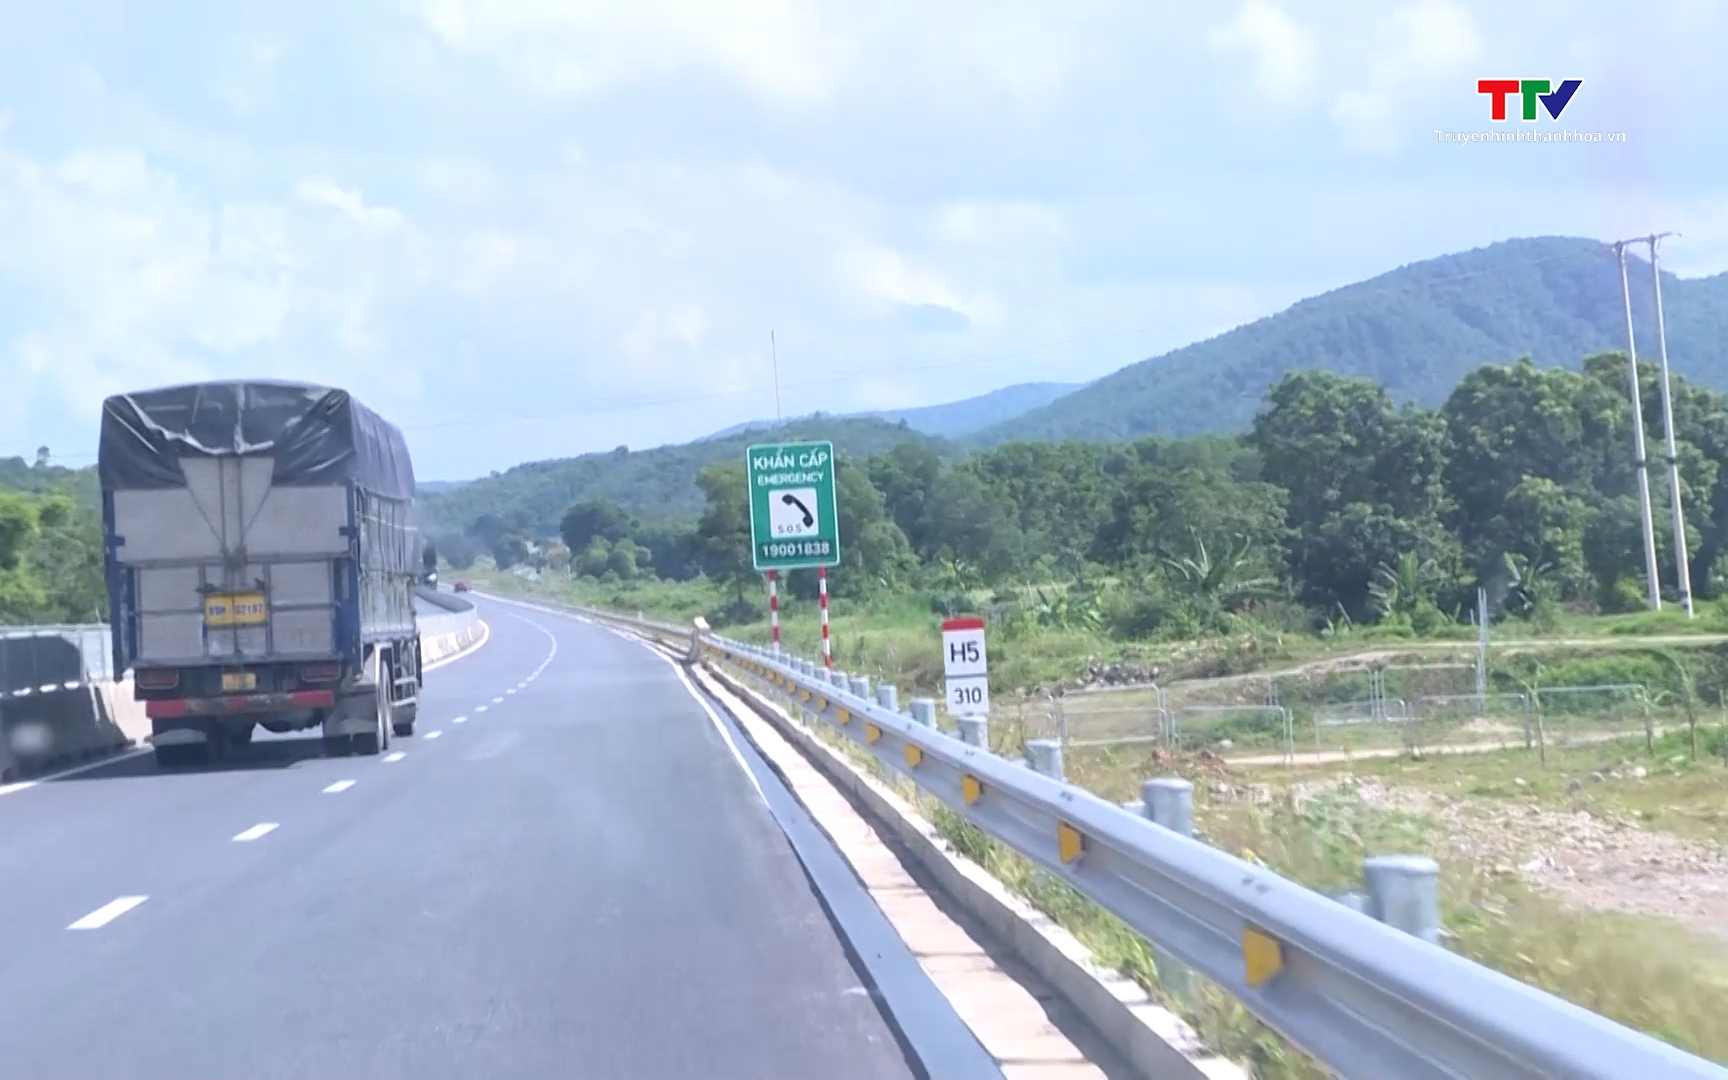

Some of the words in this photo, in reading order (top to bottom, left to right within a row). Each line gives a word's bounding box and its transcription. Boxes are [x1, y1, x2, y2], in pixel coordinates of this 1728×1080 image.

[799, 447, 828, 468] CẤP
[757, 472, 824, 487] EMERGENCY
[763, 542, 830, 558] 19001838
[950, 640, 980, 663] H5
[954, 685, 982, 705] 310
